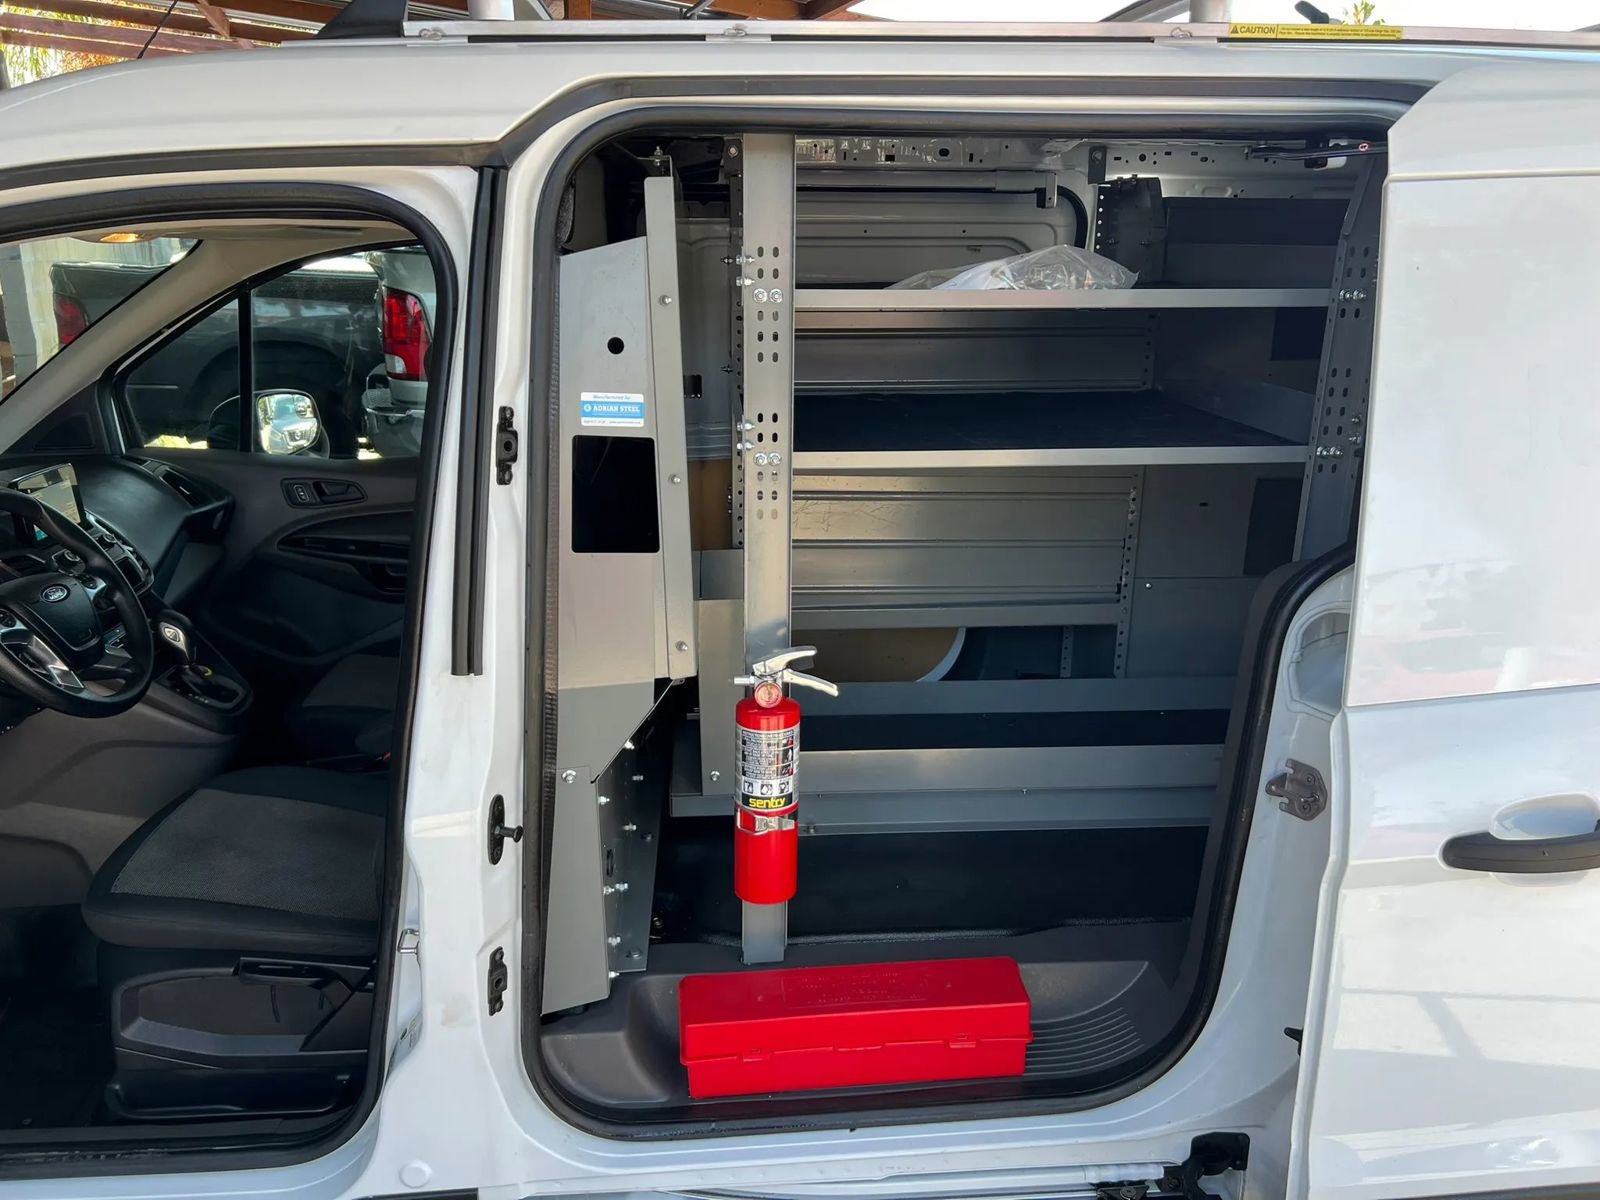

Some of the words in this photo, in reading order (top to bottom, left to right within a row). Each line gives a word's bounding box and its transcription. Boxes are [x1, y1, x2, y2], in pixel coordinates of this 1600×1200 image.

[1240, 25, 1275, 34] CAUTION
[593, 404, 619, 412] ADRIAN
[620, 405, 641, 413] STEEL
[749, 797, 785, 808] sentry
